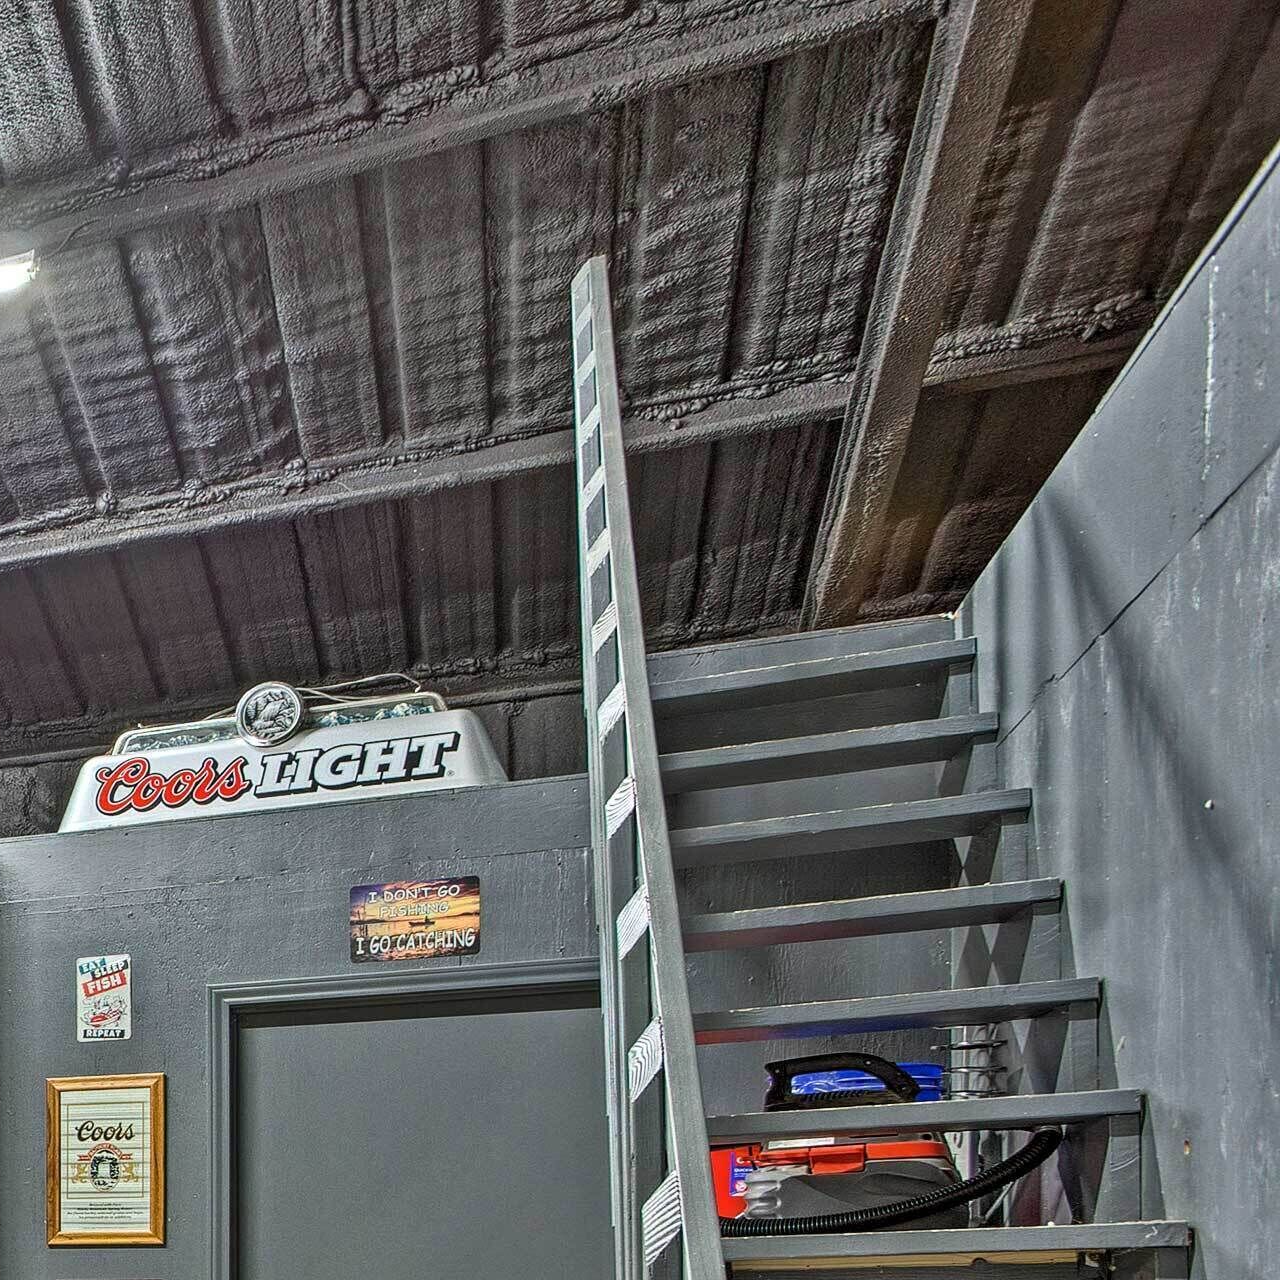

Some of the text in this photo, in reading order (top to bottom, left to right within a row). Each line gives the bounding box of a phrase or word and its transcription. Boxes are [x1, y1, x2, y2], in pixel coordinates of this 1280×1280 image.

[96, 732, 461, 815] Coors LIGHT
[369, 884, 460, 903] I DON'T GO
[380, 901, 449, 918] FISHING
[356, 928, 476, 955] I GO CATCHING
[82, 959, 104, 973] EAT
[94, 961, 126, 978] SLEEP
[86, 973, 122, 994] FISH
[86, 1029, 122, 1038] REPEAT
[75, 1120, 137, 1142] Coors
